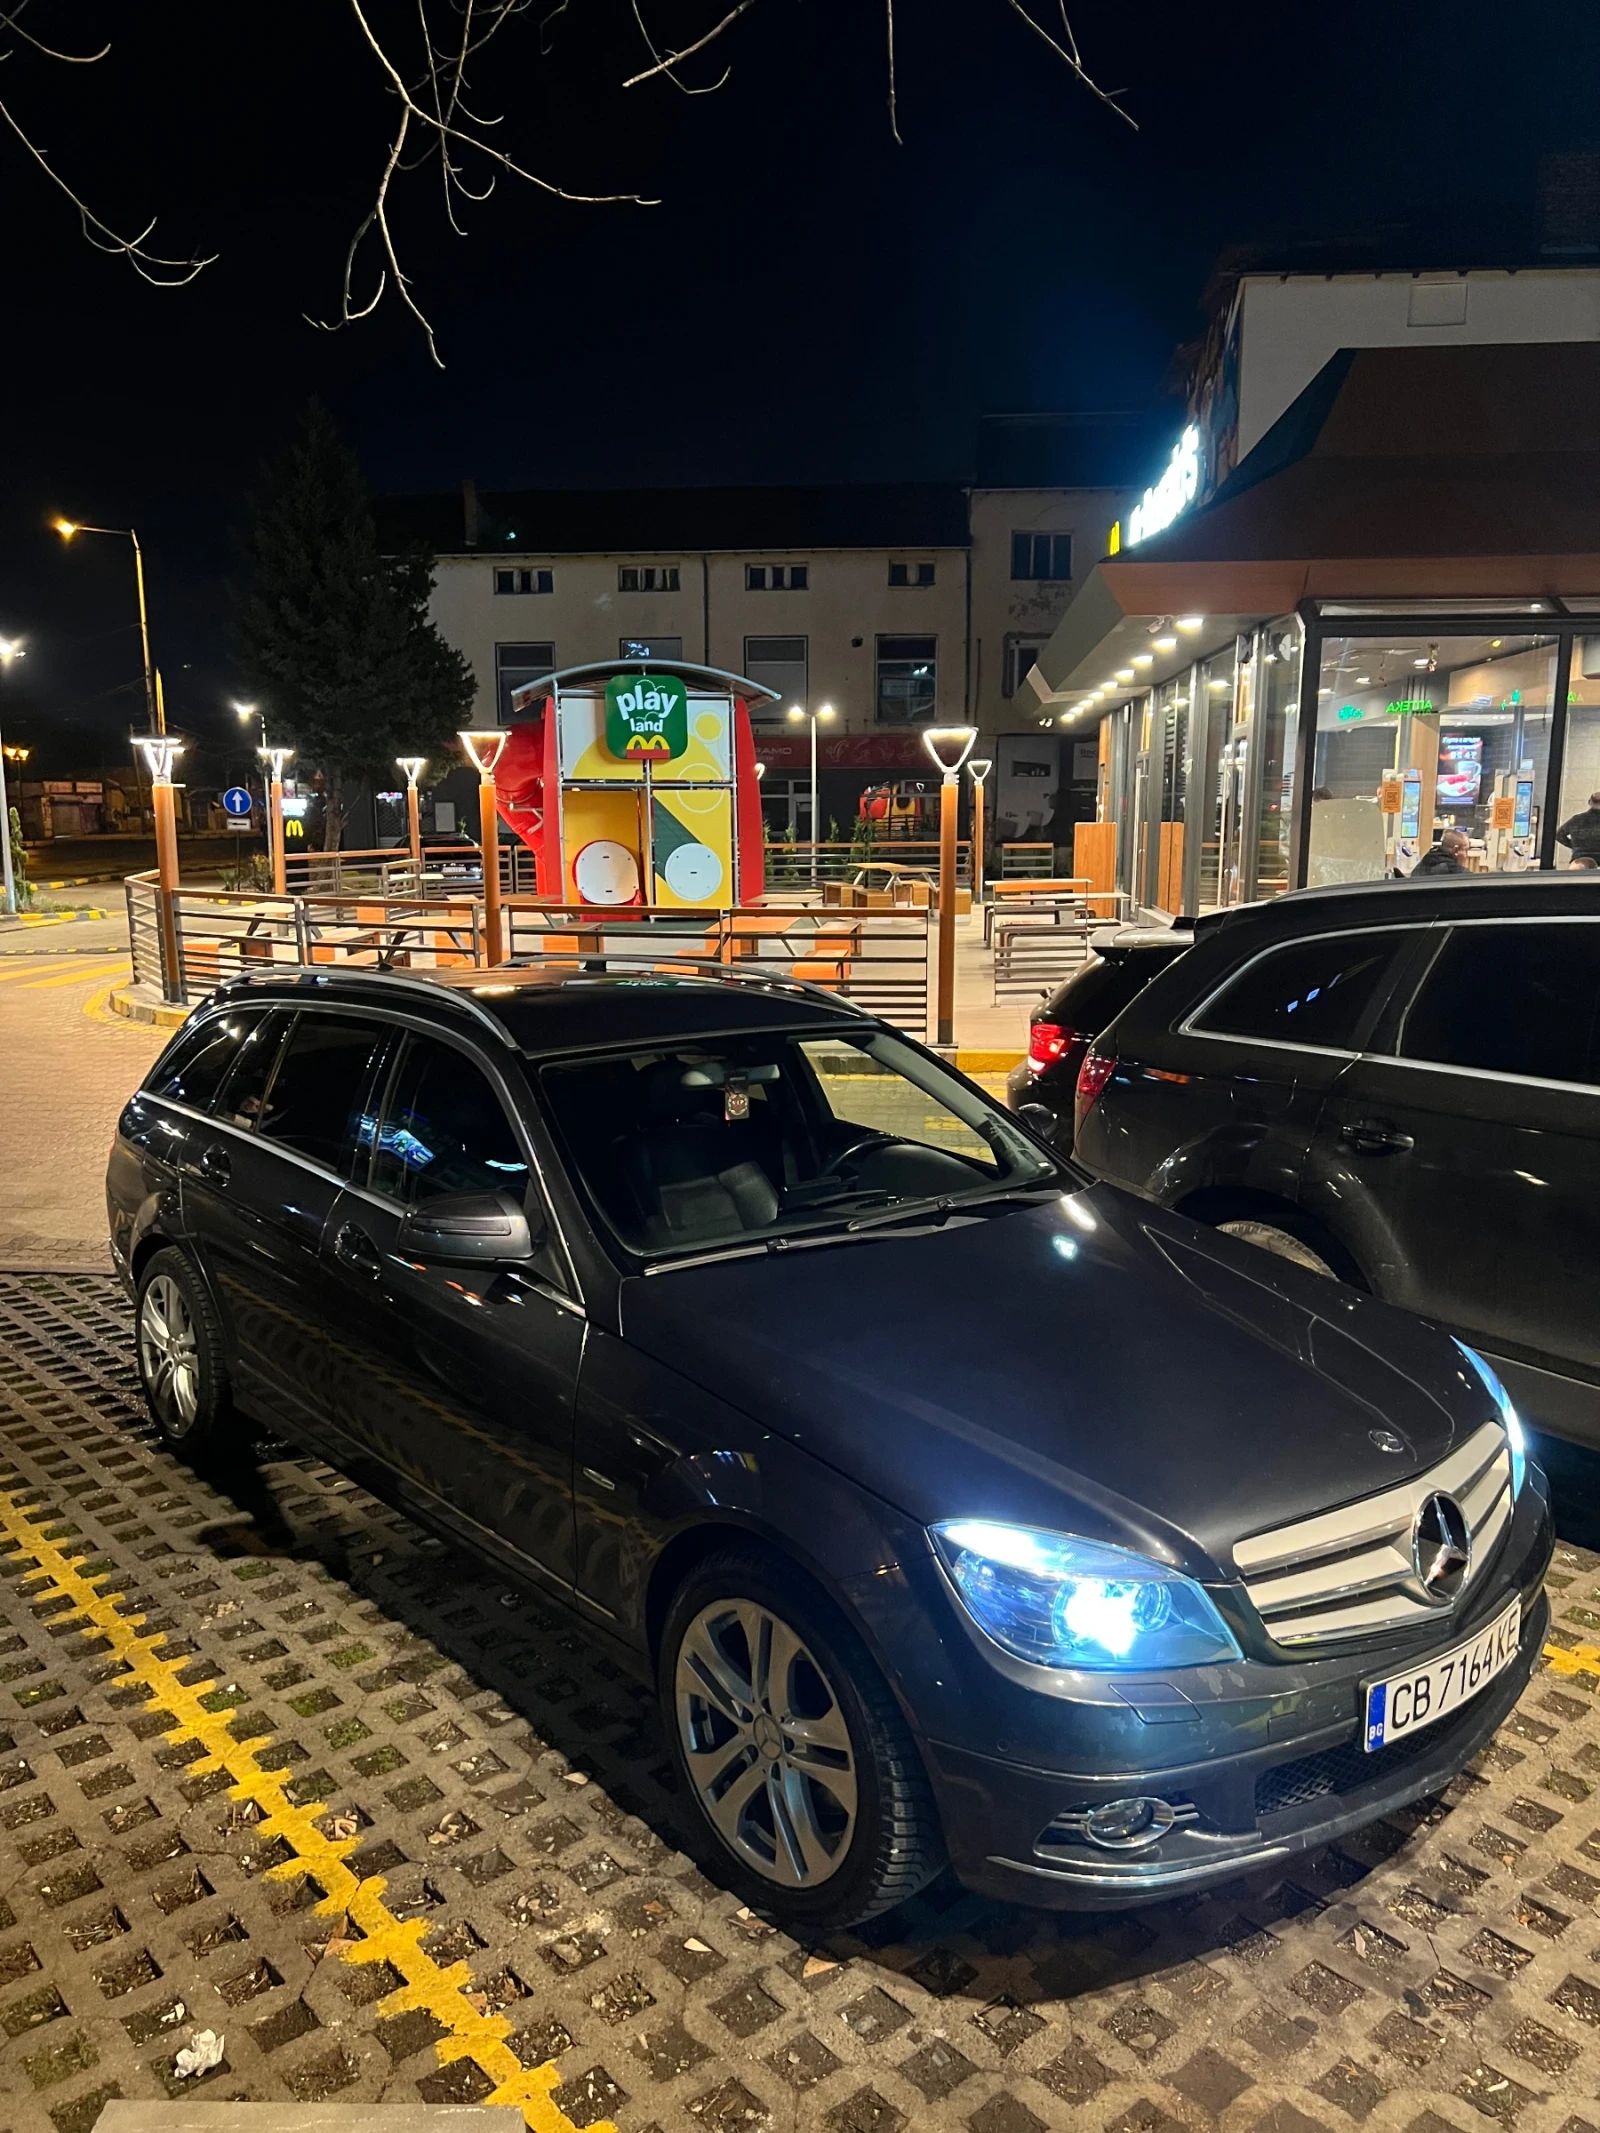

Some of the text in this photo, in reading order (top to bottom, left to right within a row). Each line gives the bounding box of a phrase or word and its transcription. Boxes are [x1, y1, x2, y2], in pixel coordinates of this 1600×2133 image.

[616, 685, 679, 720] play
[630, 718, 664, 732] land
[1391, 1610, 1518, 1730] CB 7164 KE
[1369, 1724, 1383, 1739] BG
